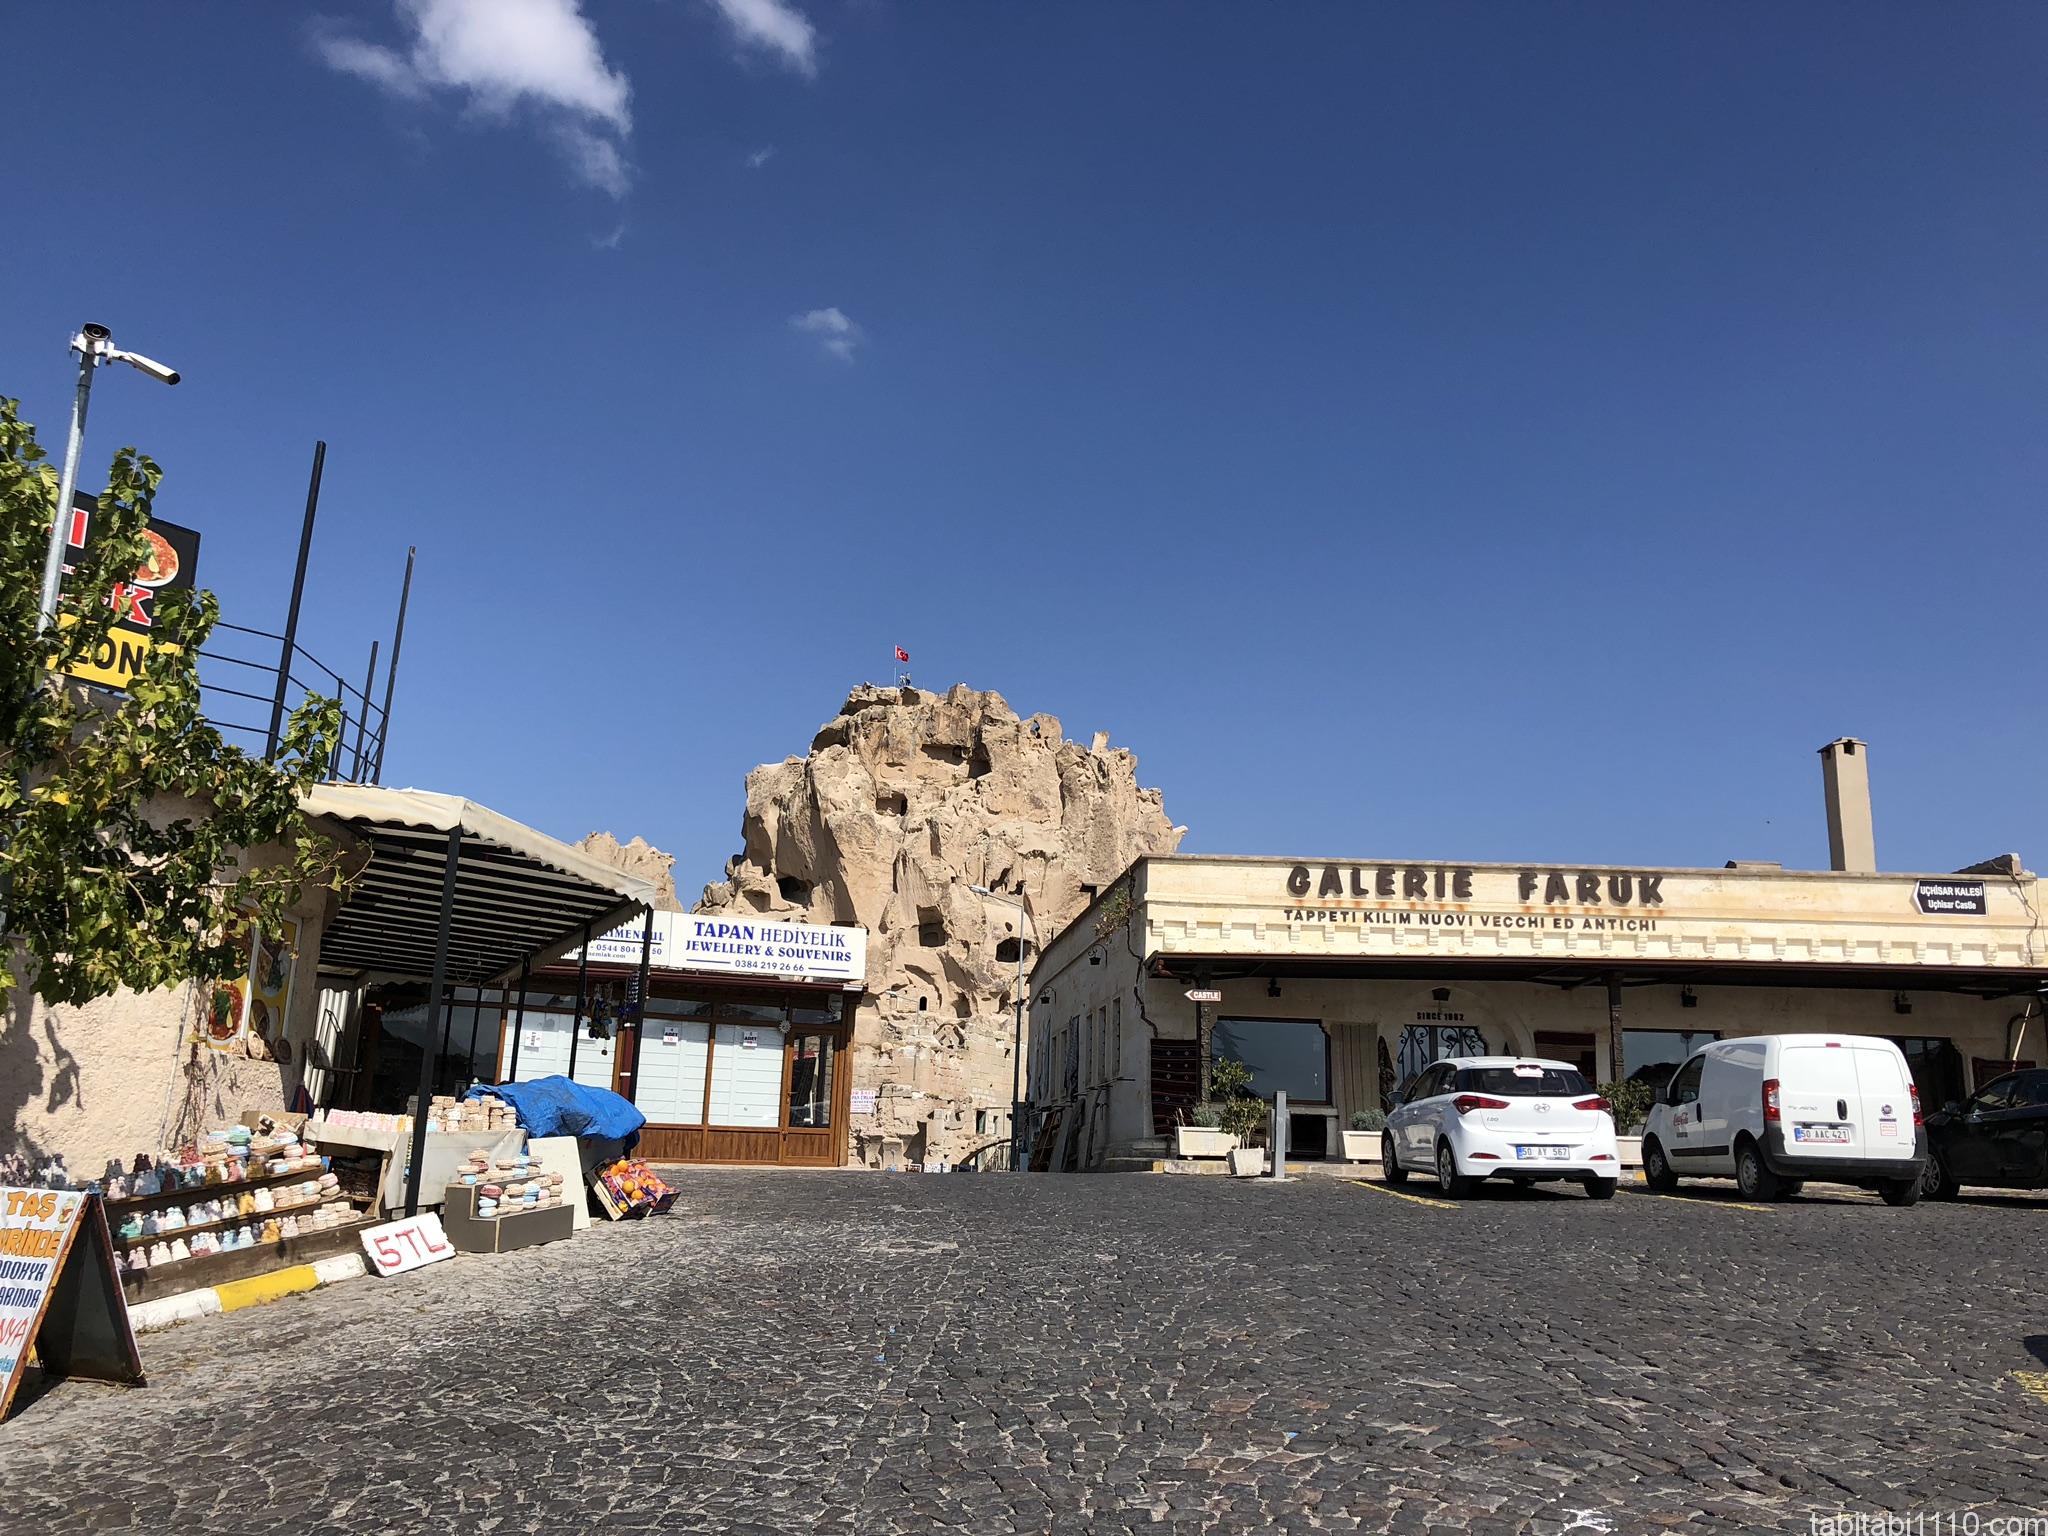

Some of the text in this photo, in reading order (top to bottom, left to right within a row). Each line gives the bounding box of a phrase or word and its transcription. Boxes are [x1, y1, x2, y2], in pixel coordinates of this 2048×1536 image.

[1287, 866, 1664, 904] GALERIE FARUK
[1920, 884, 1983, 897] UÇHİSAR KALESİ
[1955, 900, 1977, 909] Castle
[1284, 909, 1656, 931] TAPPETI KILIM NUOVI VECCHI ED ANTICHI
[694, 921, 846, 948] TAPAN HEDİYELİK
[596, 943, 618, 952] 0544
[620, 945, 636, 953] 804
[652, 947, 662, 955] 50
[686, 940, 852, 962] JEWELLERY & SOUVENIRS
[734, 959, 804, 972] 0384 219 26 66
[1193, 991, 1219, 999] CASTLE
[1417, 1012, 1441, 1020] SINCE
[1801, 1129, 1847, 1139] 50 AAC 421
[1523, 1147, 1567, 1156] 50 AY 567
[7, 1190, 59, 1222] TAŞ
